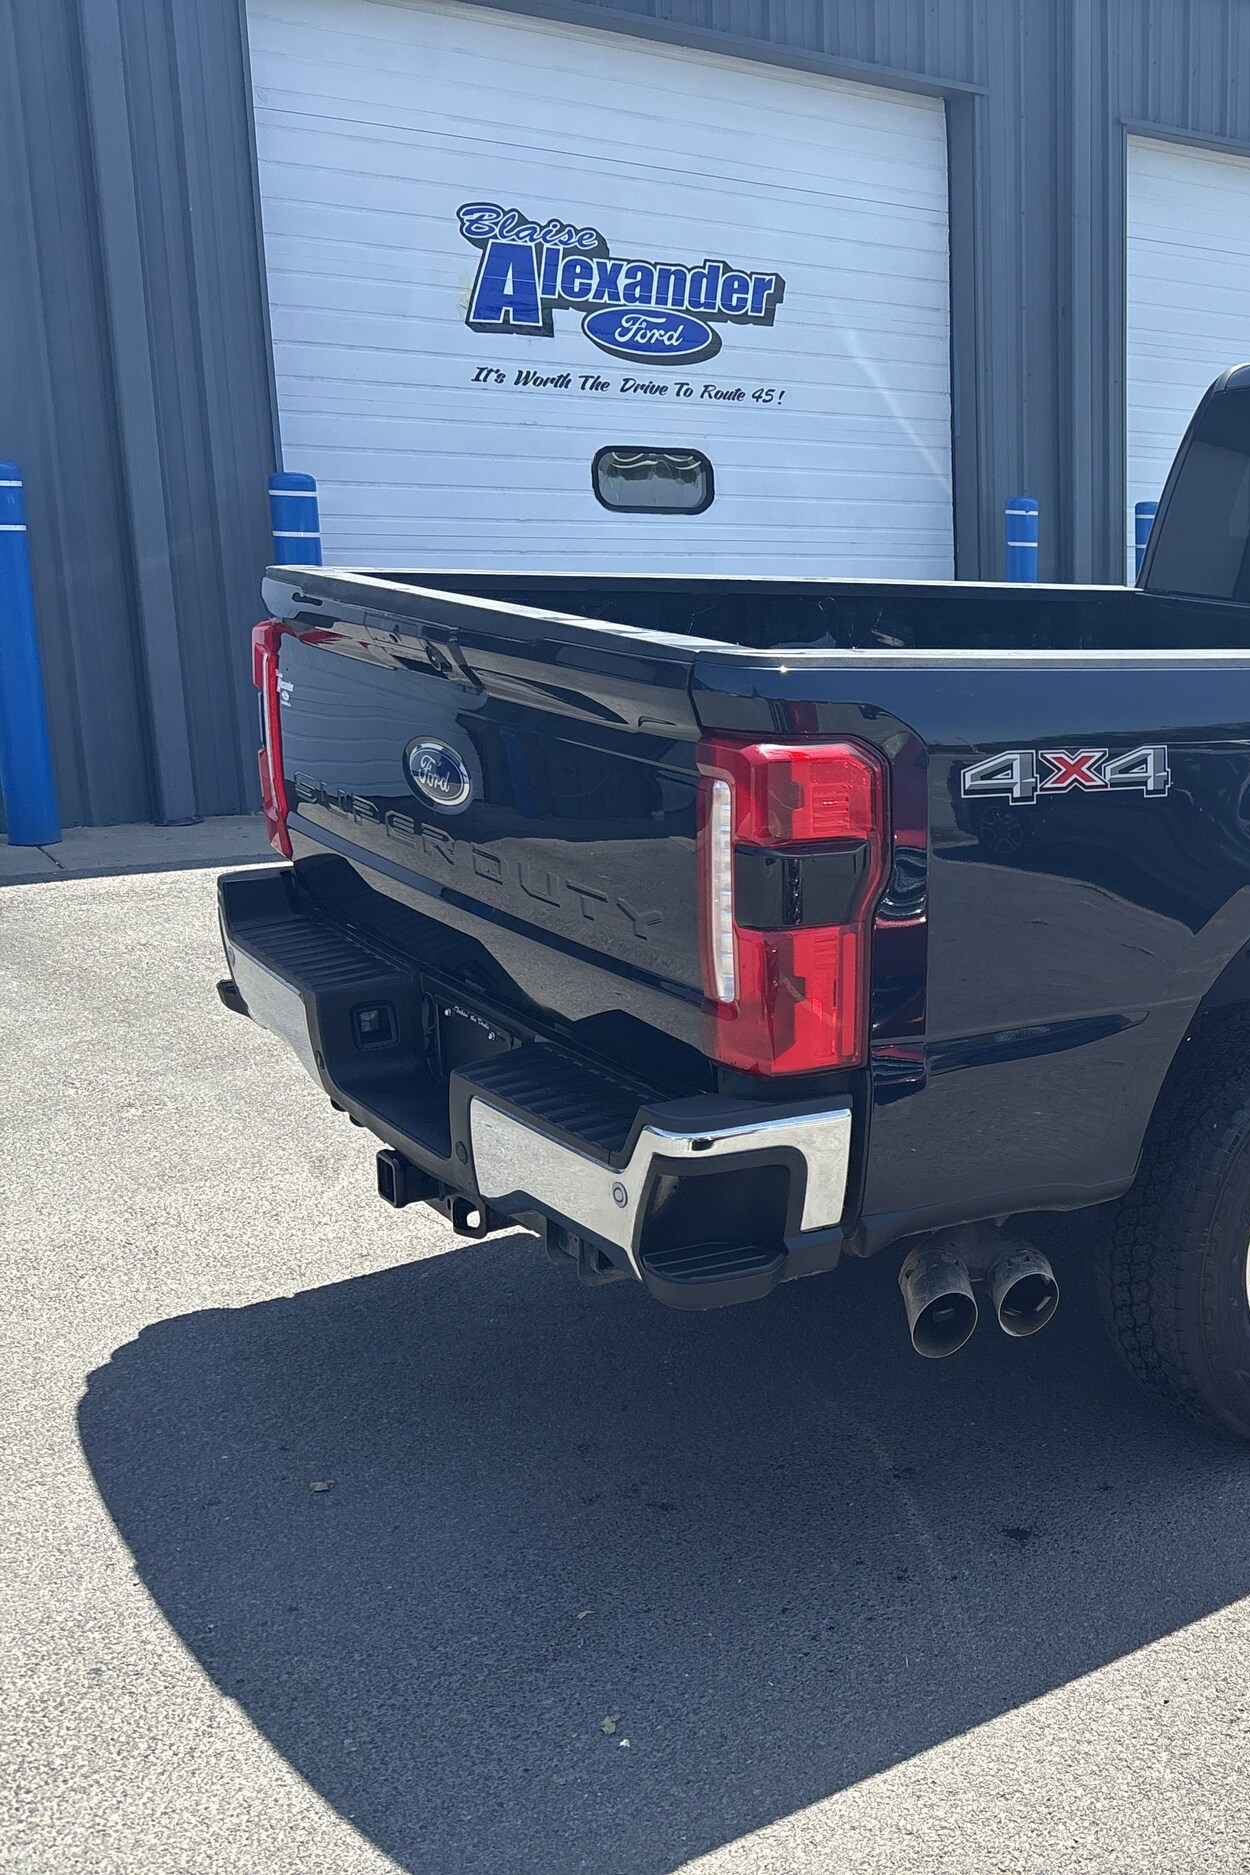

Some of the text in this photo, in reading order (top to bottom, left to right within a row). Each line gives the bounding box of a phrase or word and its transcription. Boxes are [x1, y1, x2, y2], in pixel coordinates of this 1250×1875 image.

[459, 204, 600, 249] Blaise
[468, 239, 777, 327] Alexander
[613, 313, 686, 347] Ford
[470, 366, 787, 406] It's Worth The Drive To Route 45!
[418, 754, 450, 793] Ford
[293, 770, 664, 942] SUPER DUTY
